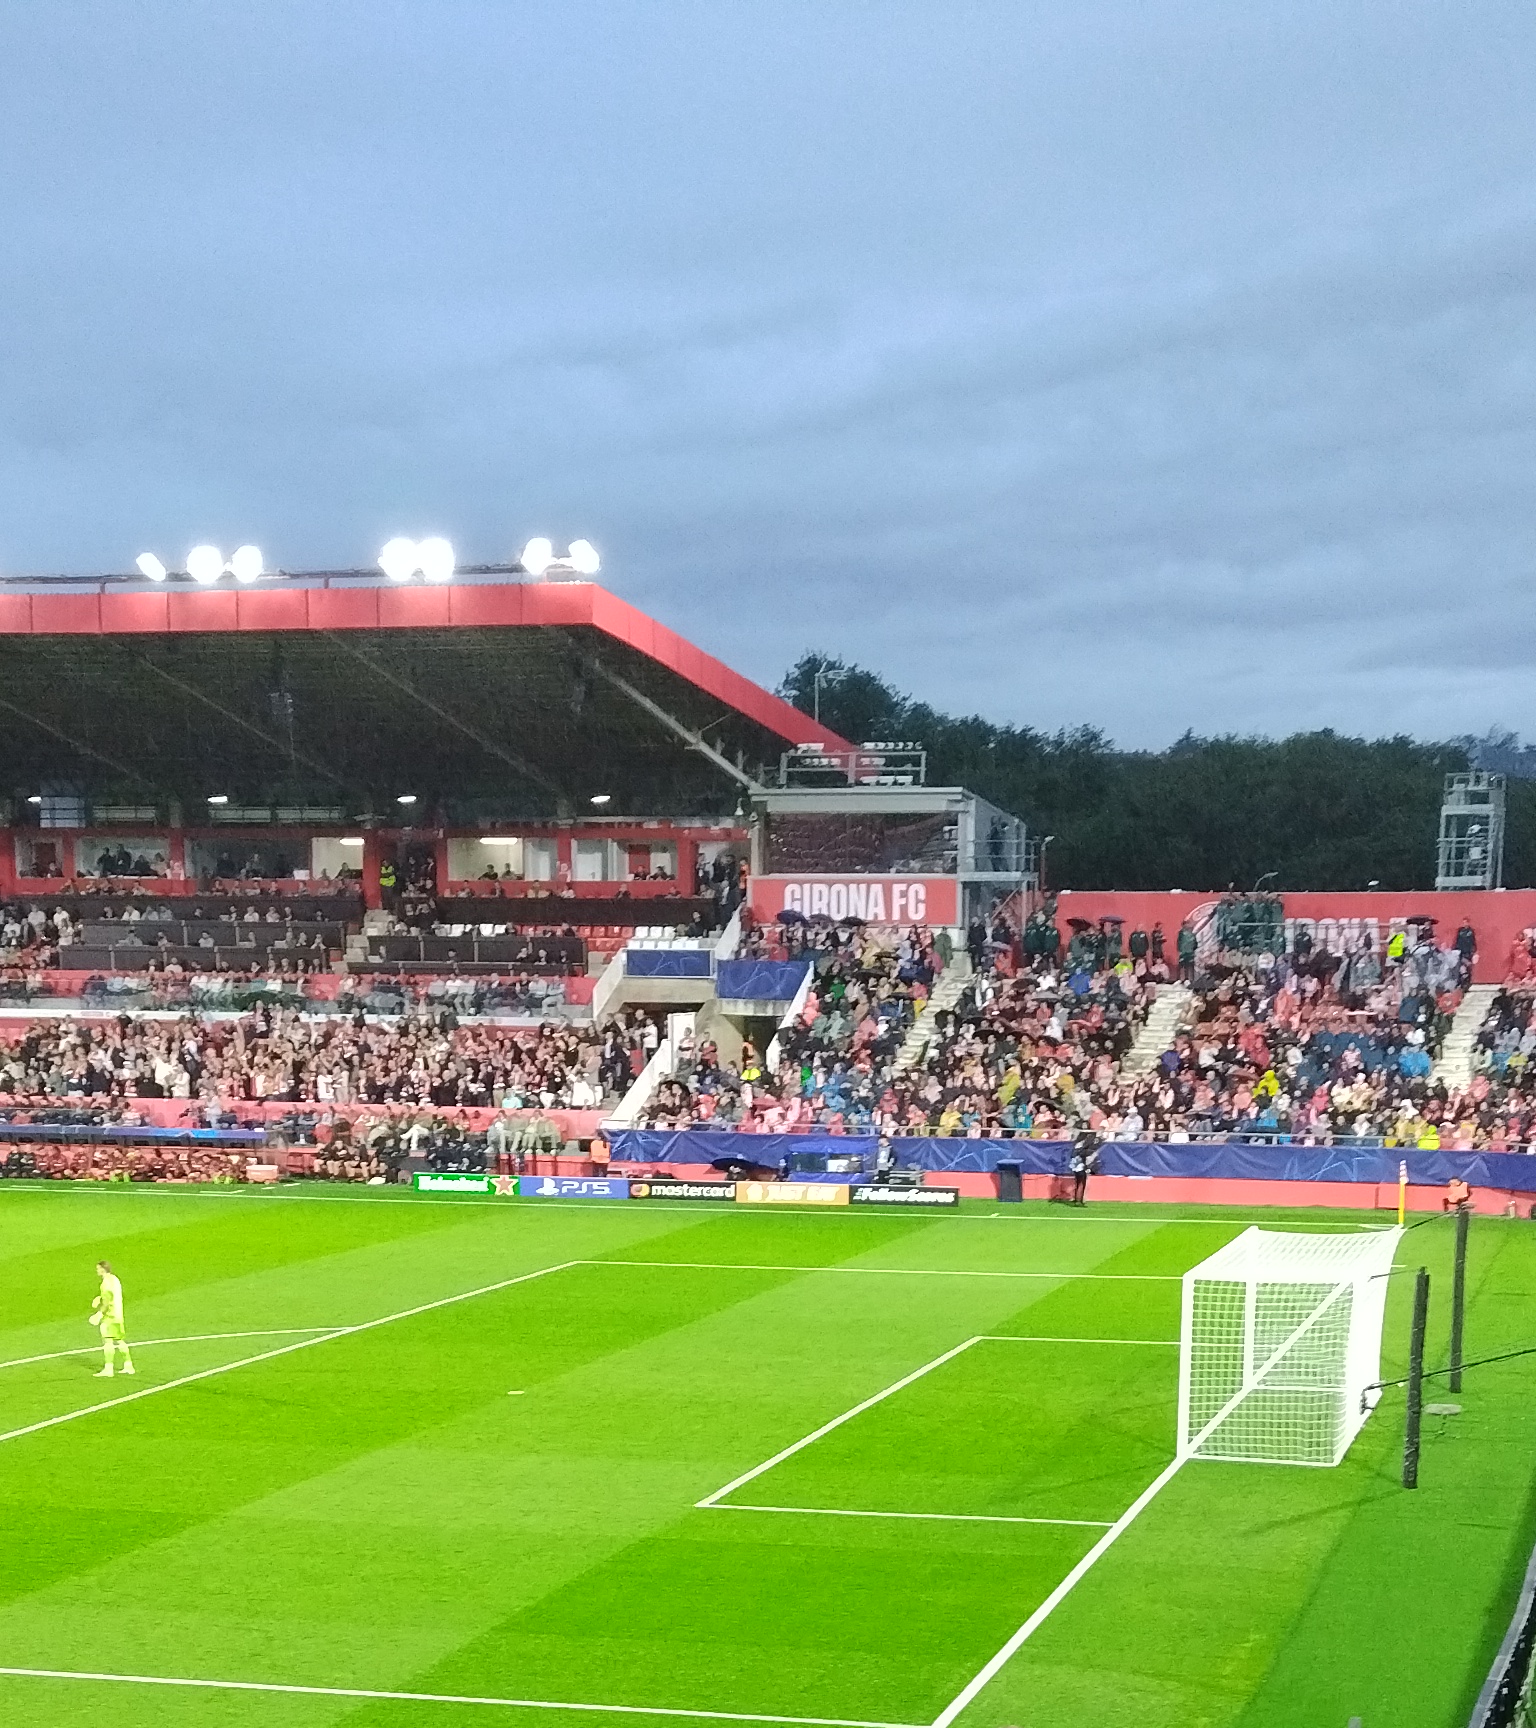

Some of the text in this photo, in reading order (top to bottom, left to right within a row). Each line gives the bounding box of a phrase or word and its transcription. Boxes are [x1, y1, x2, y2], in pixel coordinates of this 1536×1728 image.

[784, 882, 927, 921] GIRONA FC
[561, 1180, 613, 1195] PS5
[651, 1183, 736, 1198] mastercard
